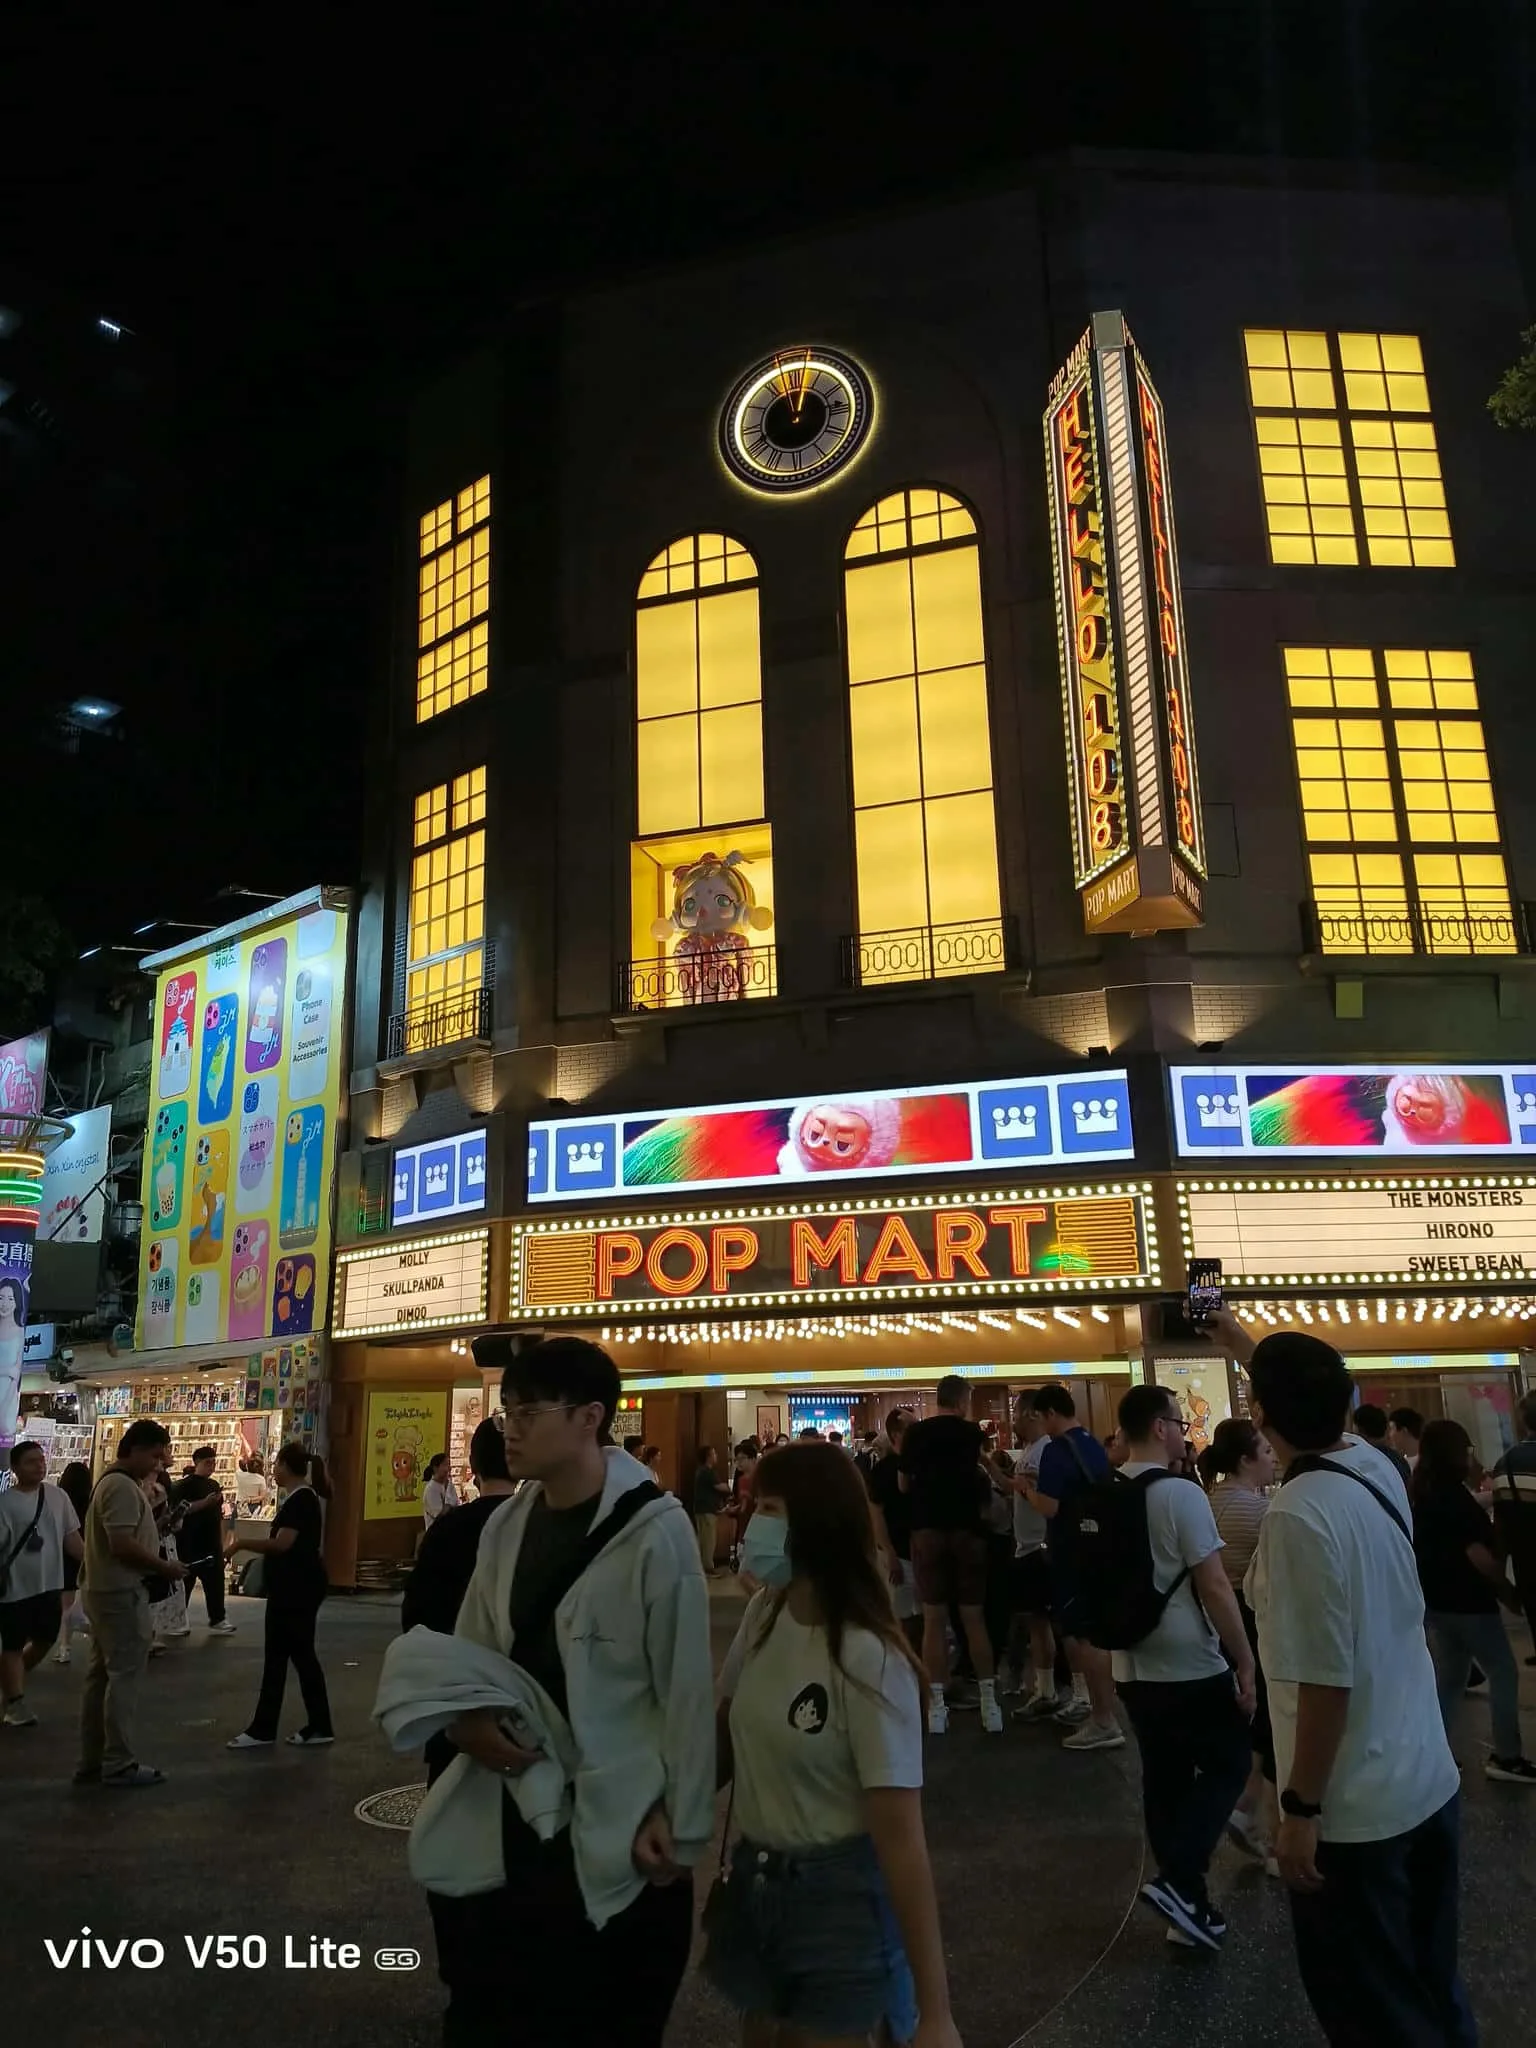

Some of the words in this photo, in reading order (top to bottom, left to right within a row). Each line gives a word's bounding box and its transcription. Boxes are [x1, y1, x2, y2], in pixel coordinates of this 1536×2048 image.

[1058, 390, 1106, 664] HELLO
[1086, 890, 1105, 921] POP
[1106, 866, 1137, 907] MART
[301, 999, 323, 1012] Phone
[303, 1014, 320, 1025] Case
[297, 1035, 325, 1050] Souvenir
[292, 1046, 328, 1063] Accessories
[1387, 1192, 1423, 1208] THE
[1427, 1190, 1524, 1208] MONSTERS
[1425, 1222, 1495, 1240] HIRONO
[399, 1251, 430, 1269] MOLLY
[596, 1226, 760, 1299] POP
[791, 1206, 1048, 1288] MART
[1408, 1256, 1470, 1272] SWEET
[1475, 1254, 1524, 1271] BEAN
[383, 1276, 445, 1297] SKULLPANDA
[397, 1305, 428, 1322] DIMOO
